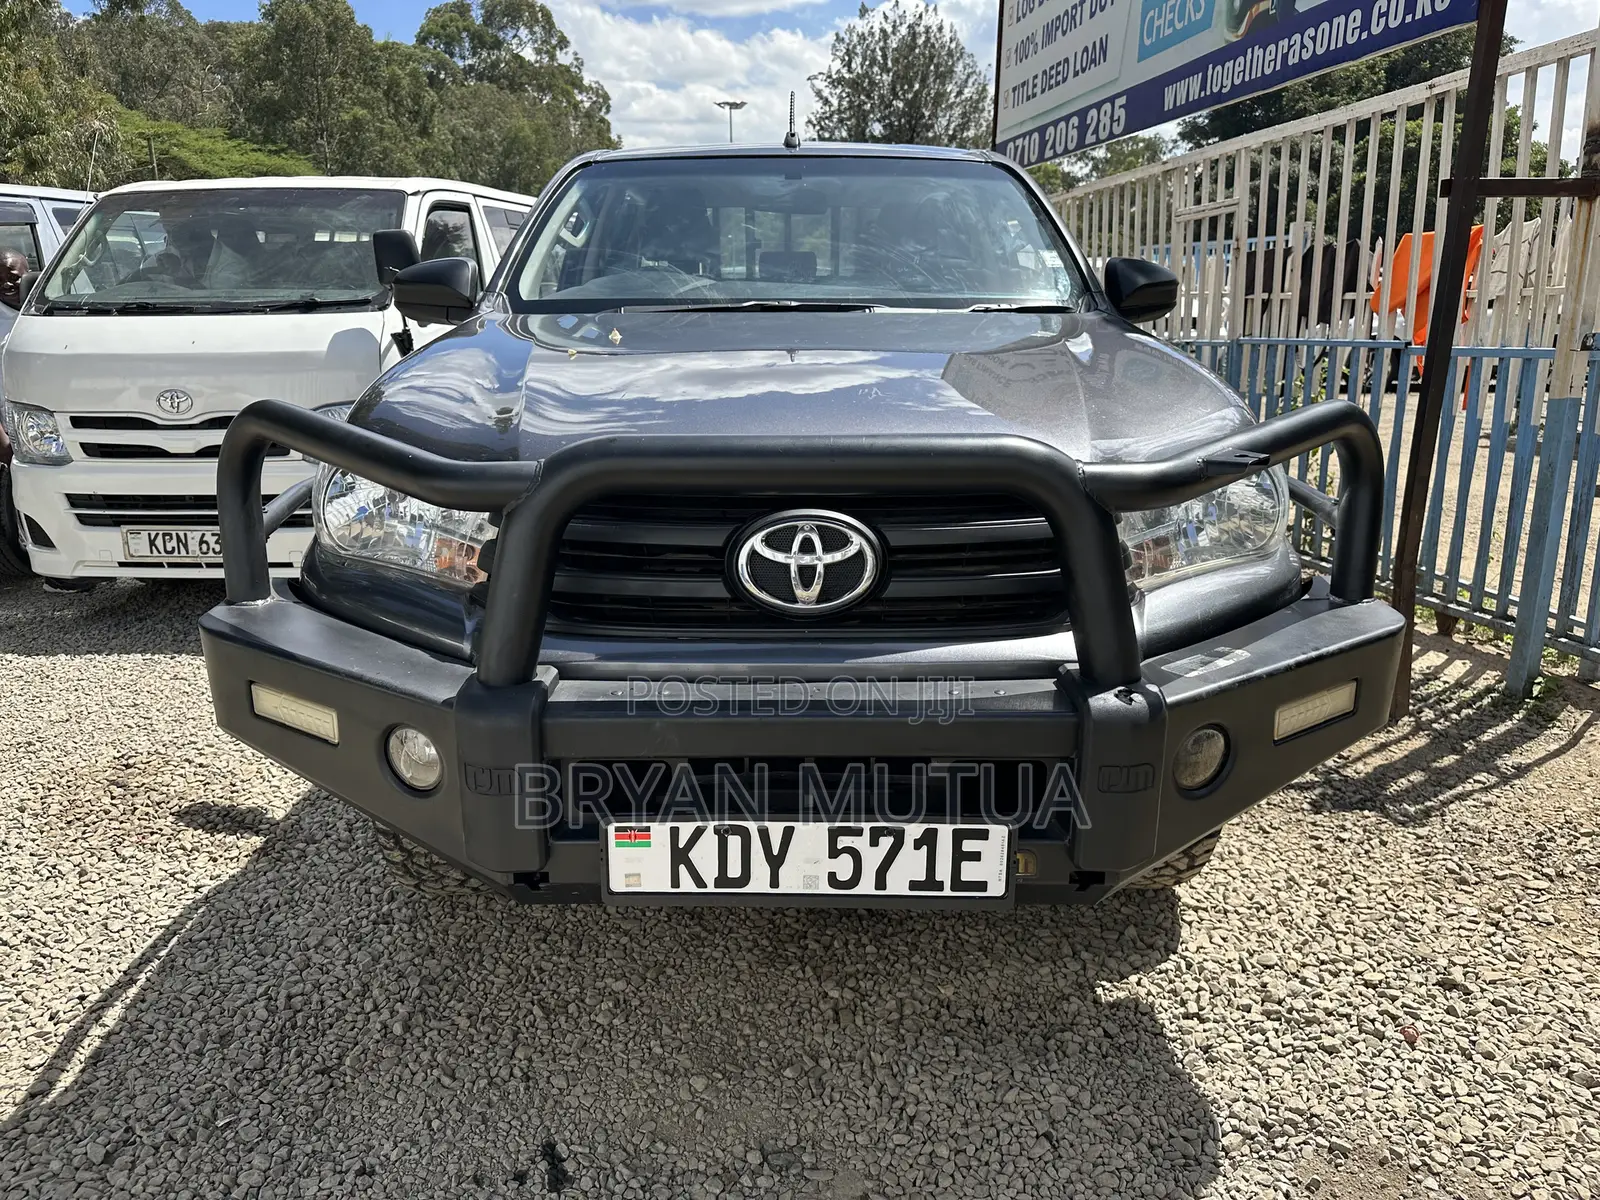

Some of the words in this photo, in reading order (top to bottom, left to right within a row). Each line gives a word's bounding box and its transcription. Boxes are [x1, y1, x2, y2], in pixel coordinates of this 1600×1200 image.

[1014, 29, 1038, 66] 100%
[1041, 0, 1086, 50] IMPORT
[1012, 74, 1038, 109] TITLE
[1040, 57, 1070, 95] DEED
[1072, 33, 1109, 79] LOAN
[1044, 116, 1079, 159] 206
[1085, 95, 1127, 145] 285
[147, 532, 189, 555] KCN
[198, 532, 222, 555] 63
[670, 824, 796, 889] KDY
[827, 826, 990, 892] 571E
